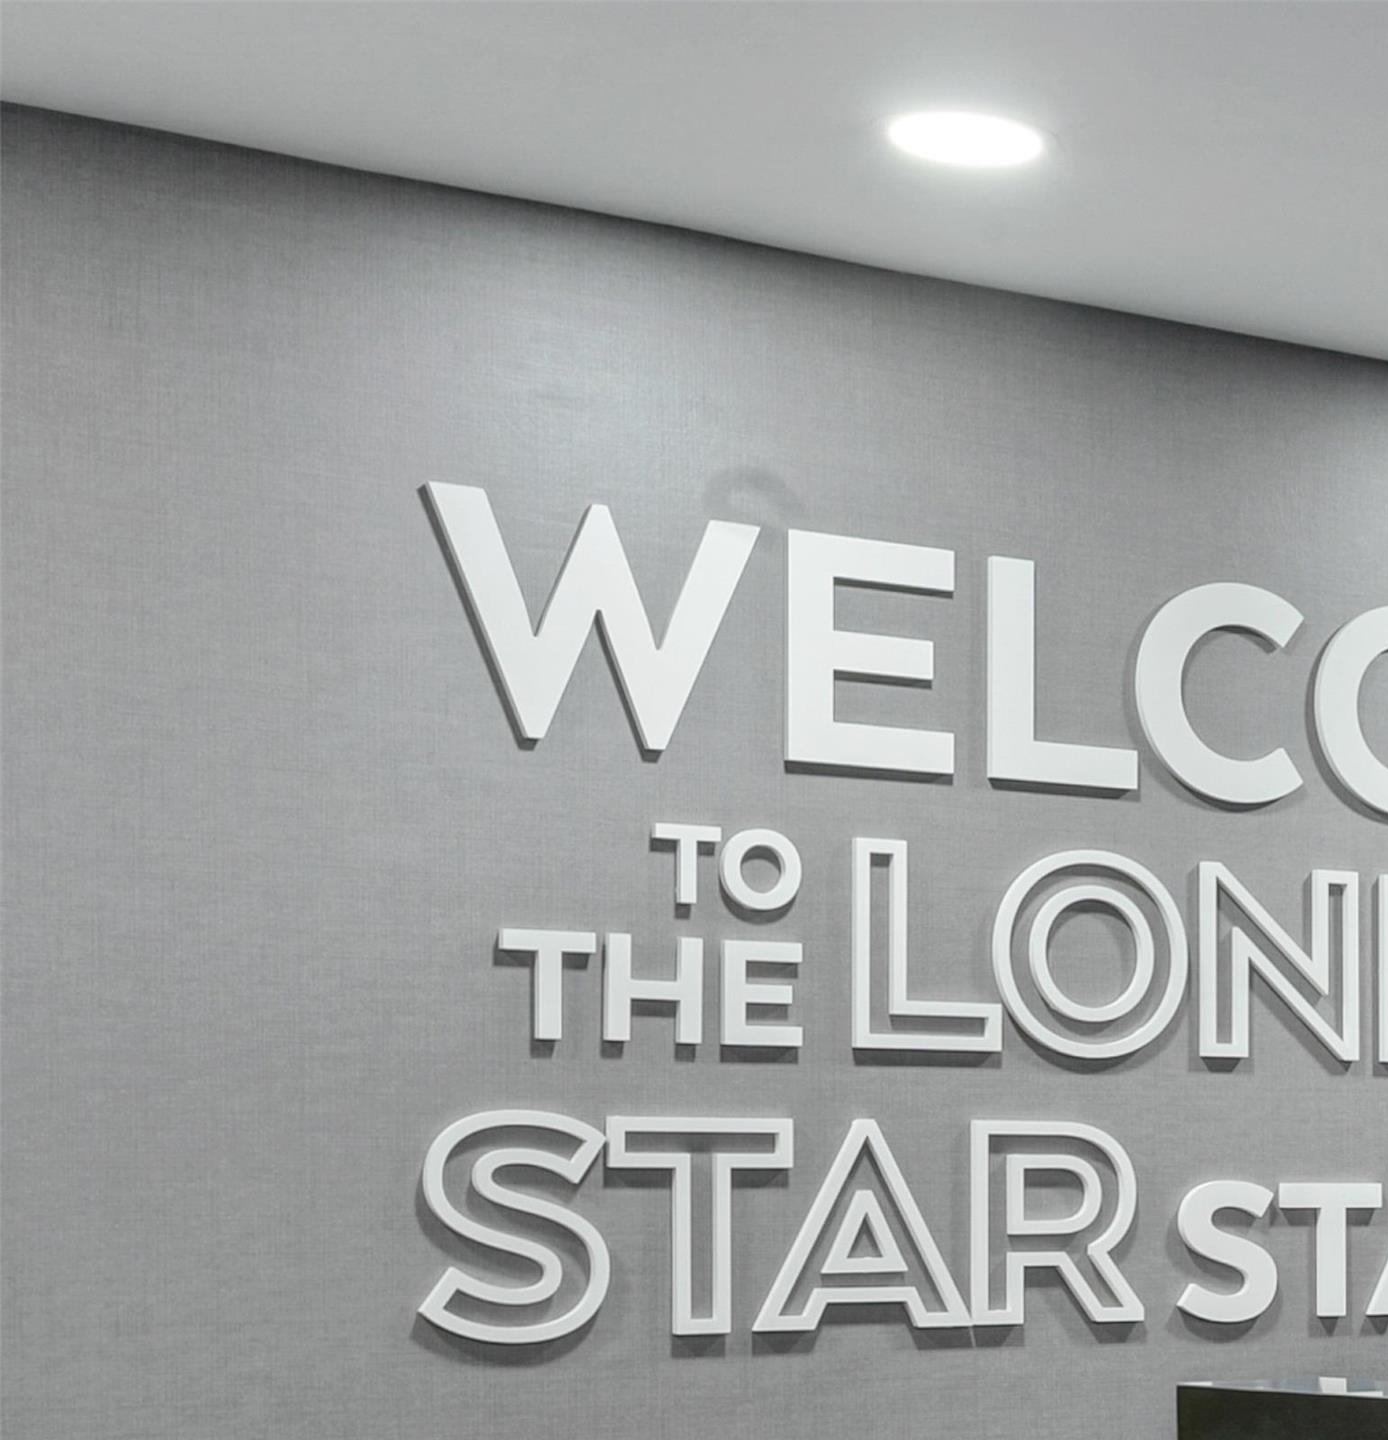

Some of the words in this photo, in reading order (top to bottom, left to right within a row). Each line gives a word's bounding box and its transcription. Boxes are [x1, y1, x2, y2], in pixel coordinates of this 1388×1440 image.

[651, 821, 802, 915] TO
[496, 926, 803, 1049] THE
[418, 1107, 1145, 1345] STAR
